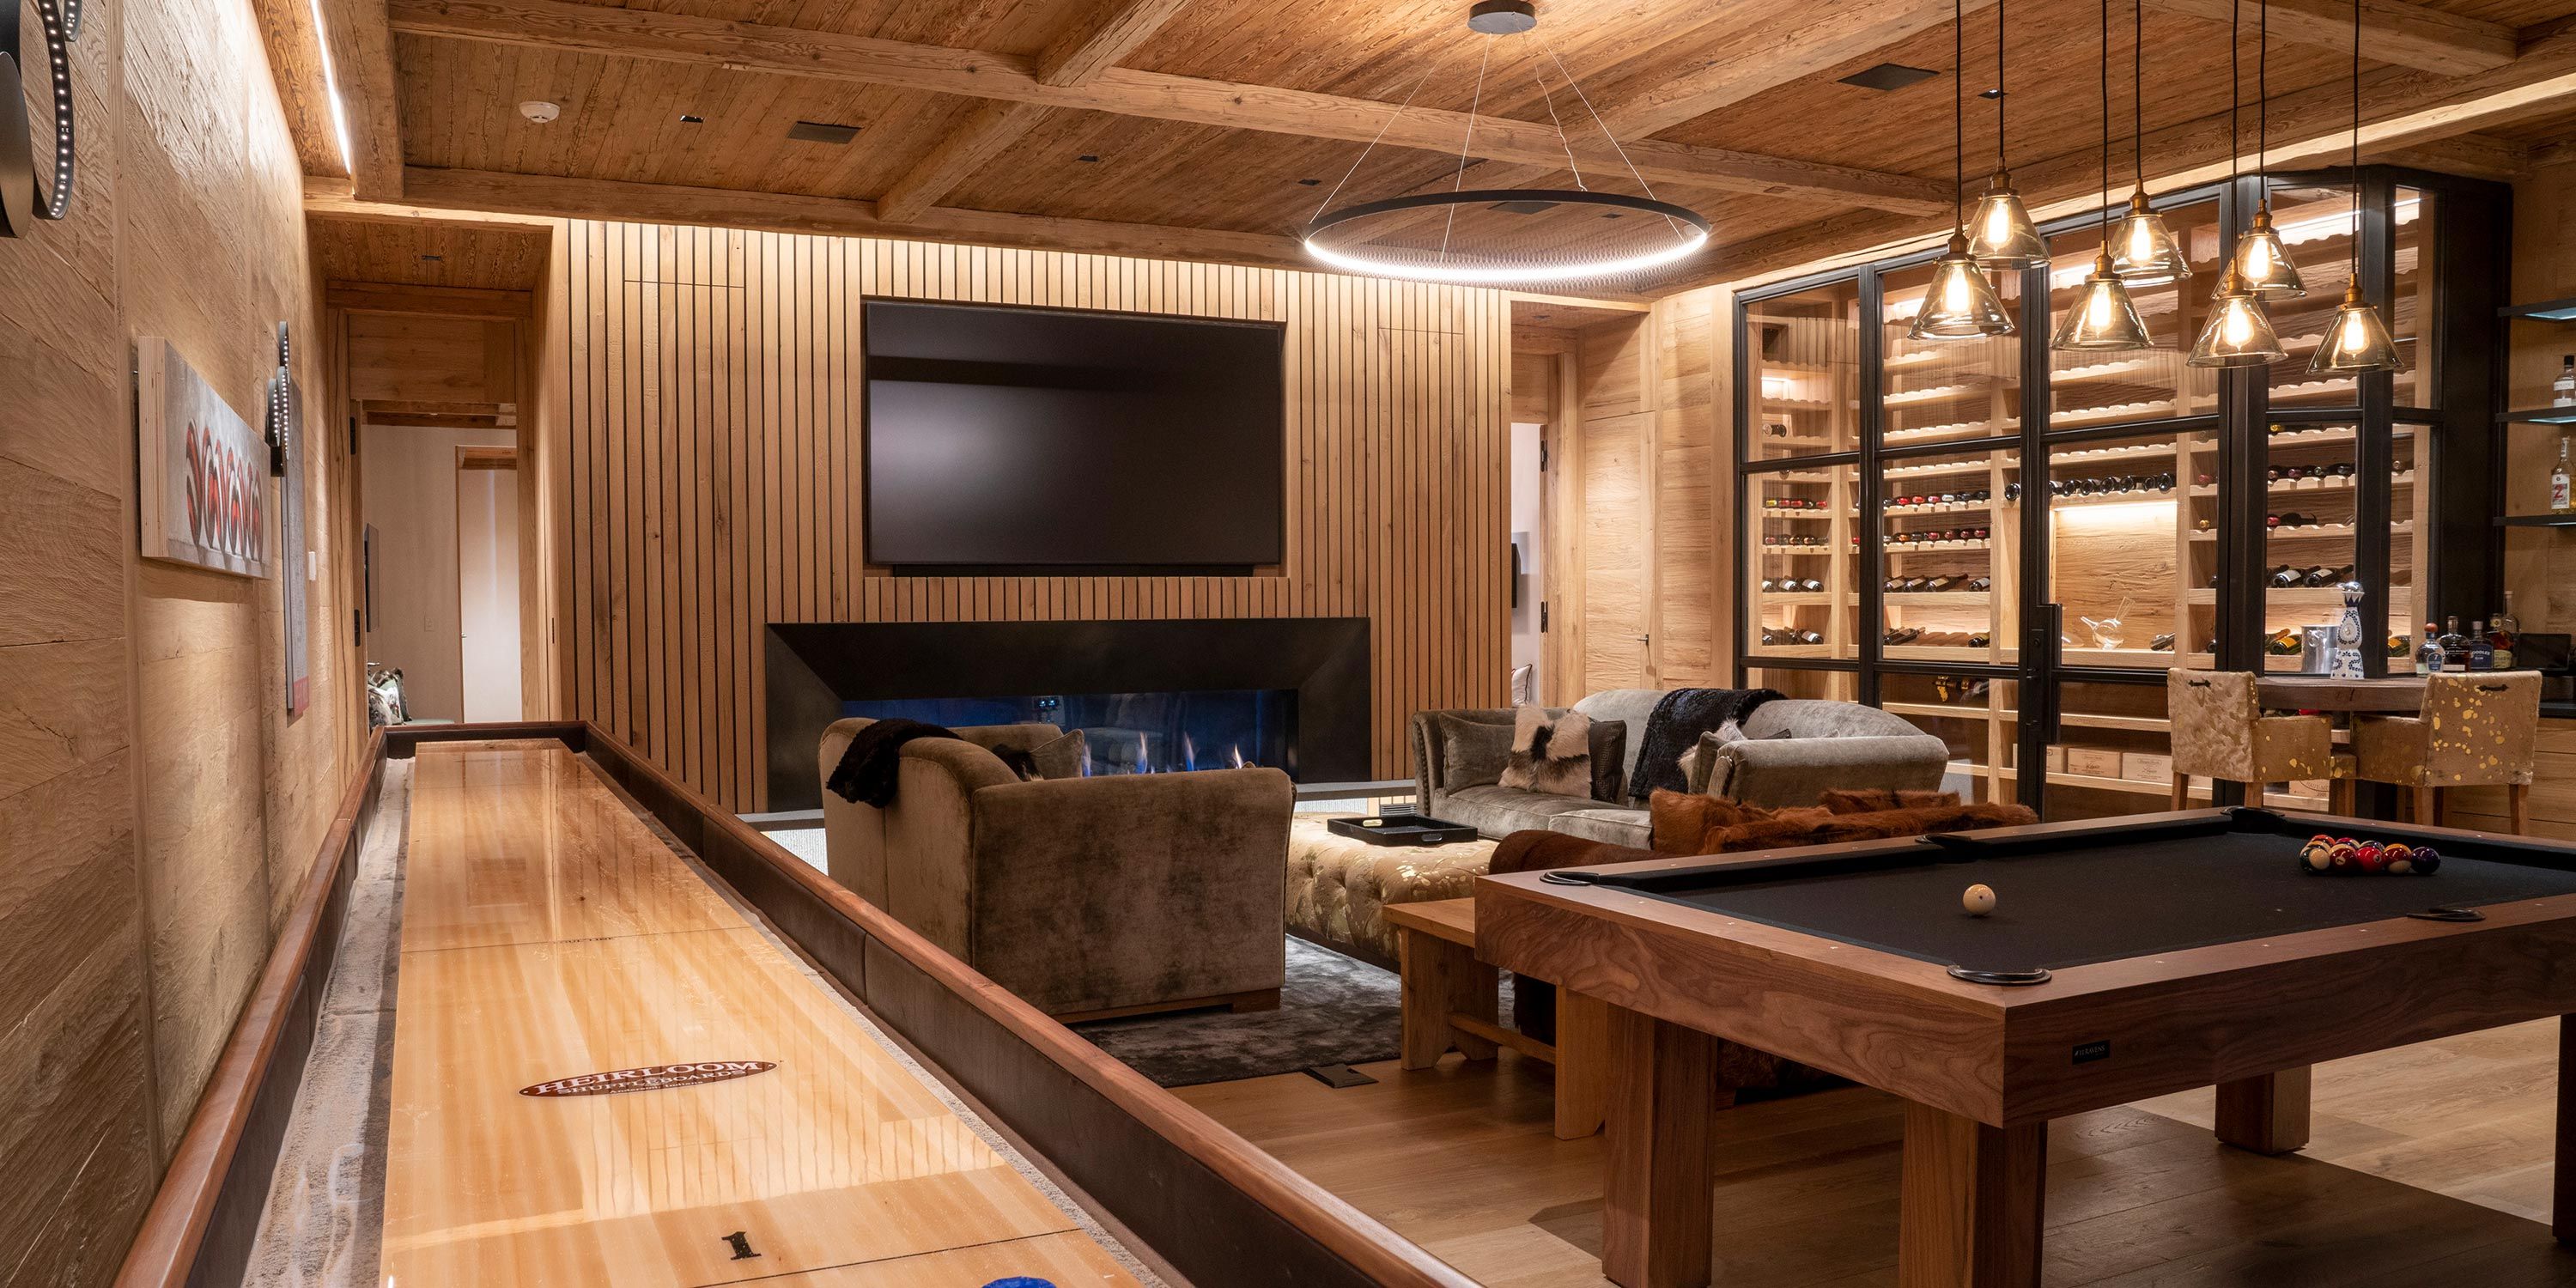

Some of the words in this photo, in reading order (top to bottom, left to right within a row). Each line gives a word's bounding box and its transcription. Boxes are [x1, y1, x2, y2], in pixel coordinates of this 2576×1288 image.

[535, 1062, 762, 1095] HEIRLOOM
[557, 1069, 746, 1094] SHUFFLEBOARDS
[721, 1231, 762, 1260] 1
